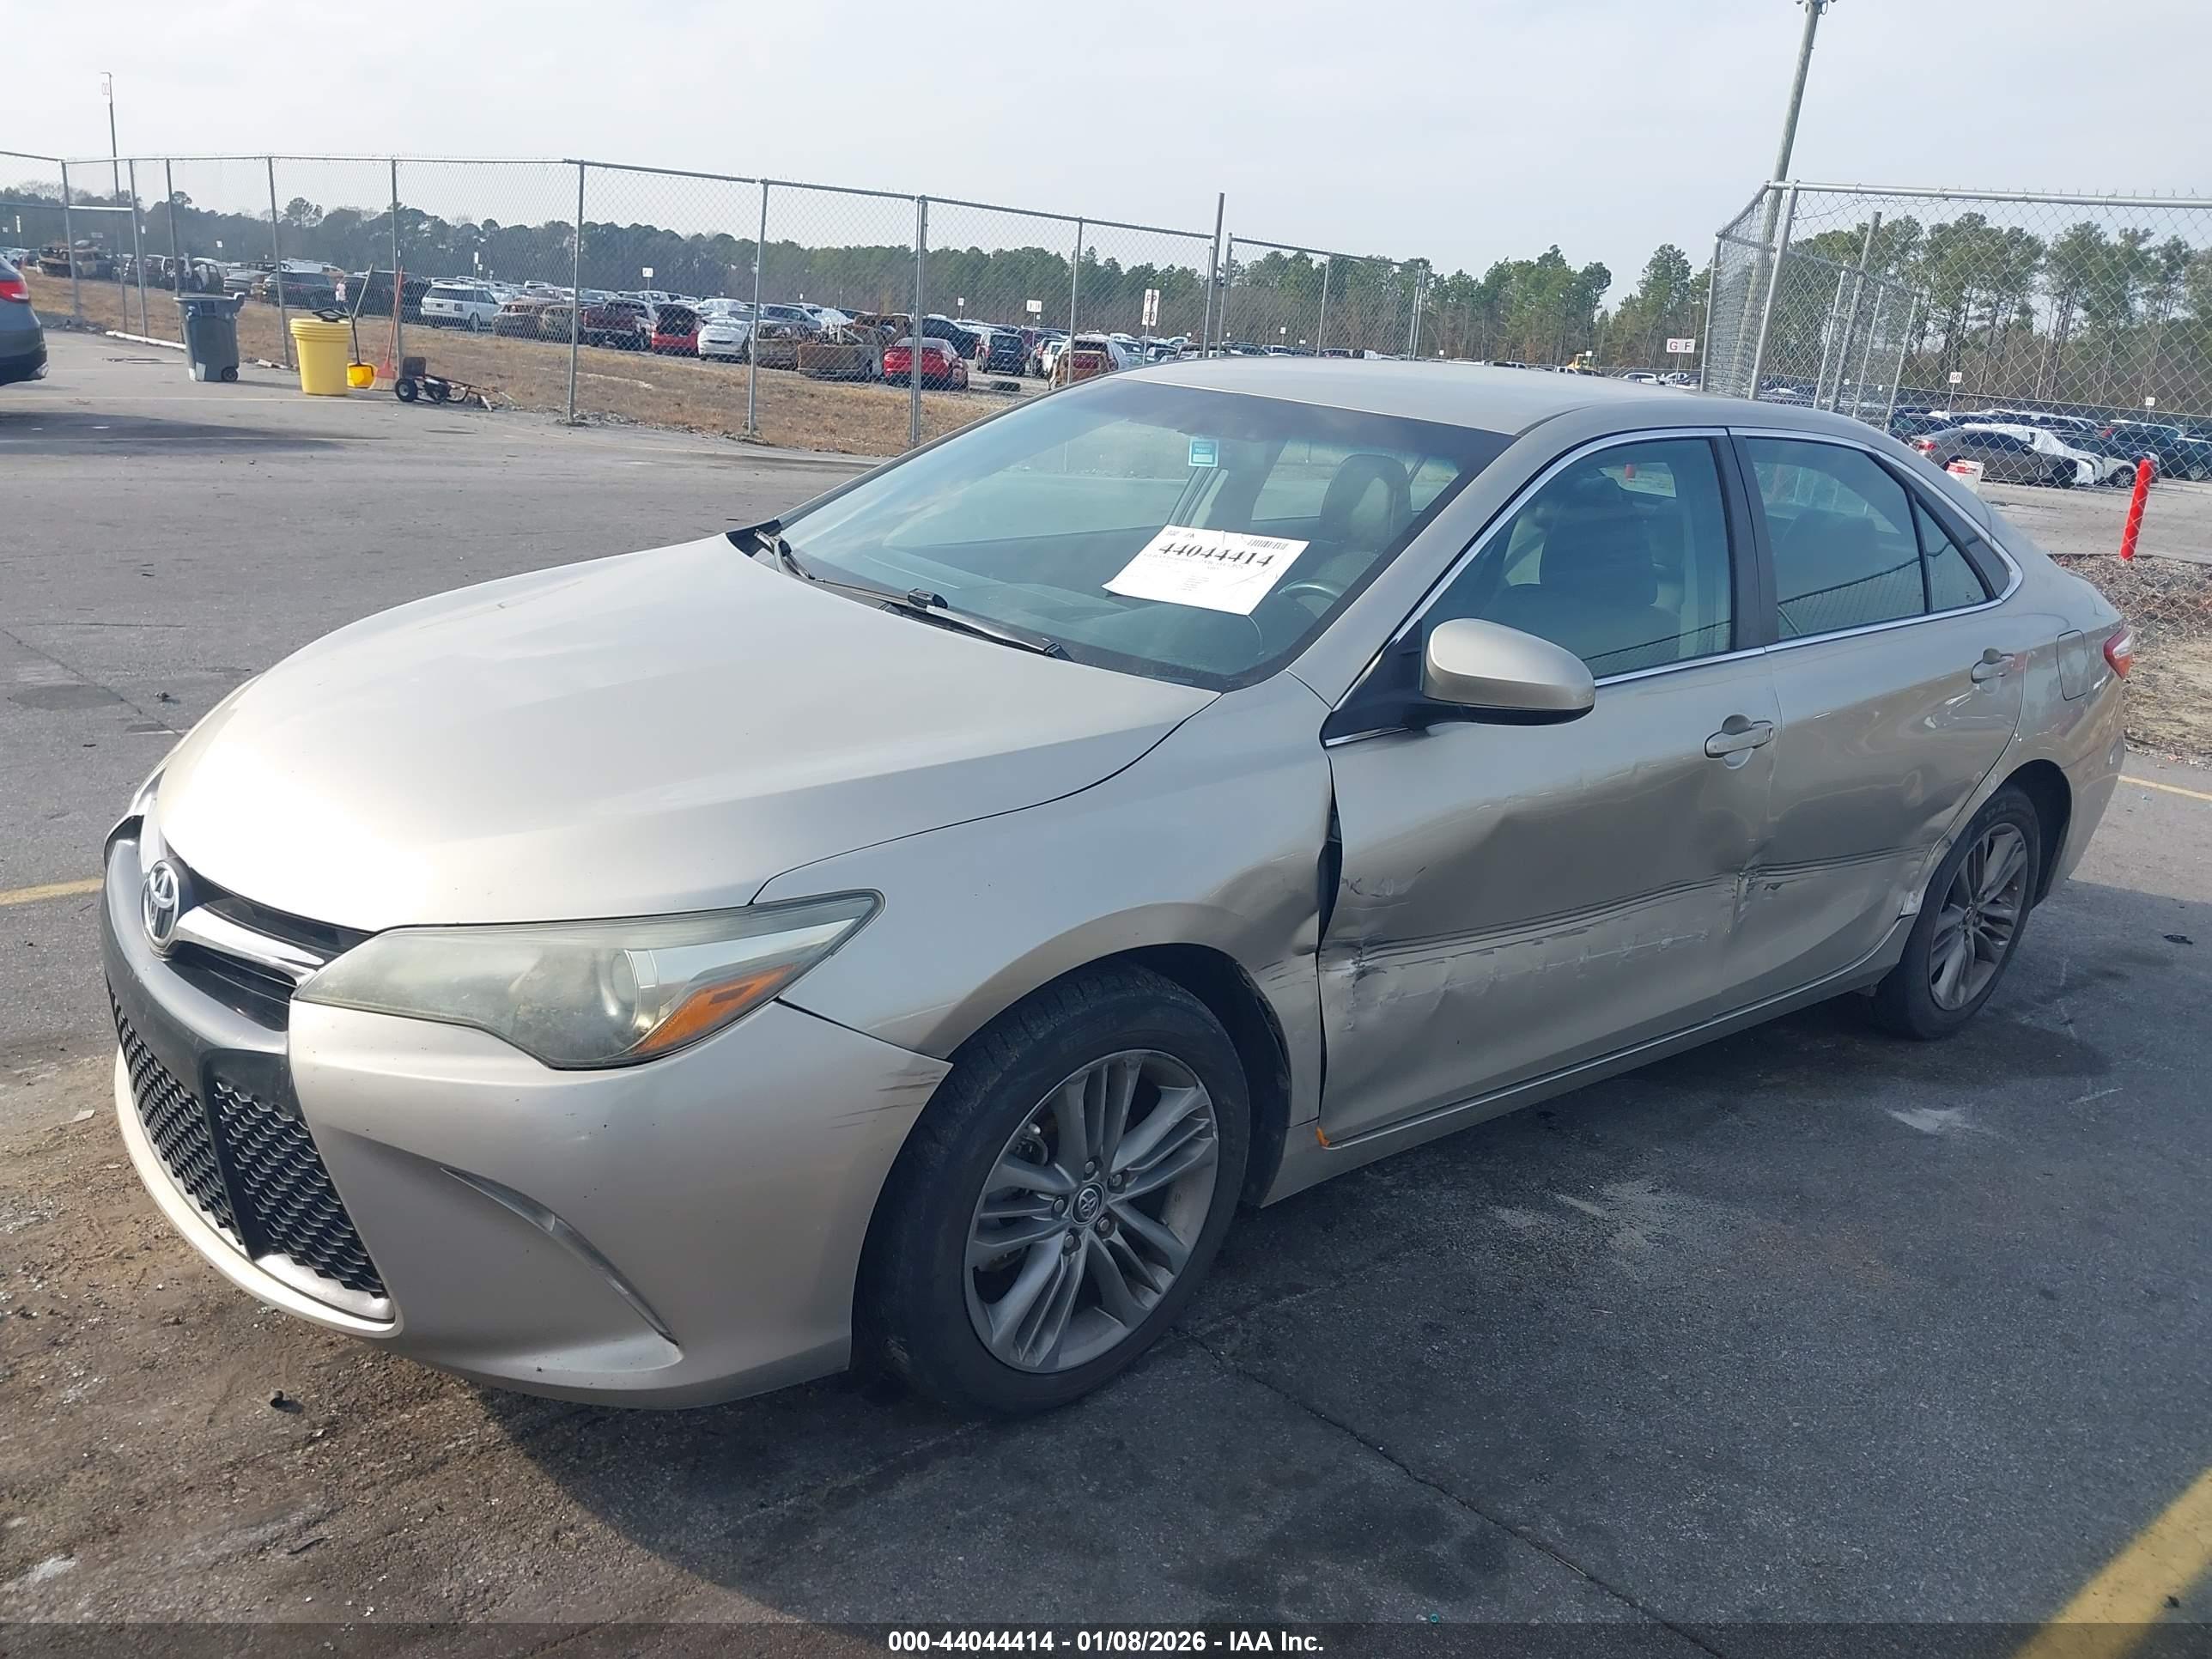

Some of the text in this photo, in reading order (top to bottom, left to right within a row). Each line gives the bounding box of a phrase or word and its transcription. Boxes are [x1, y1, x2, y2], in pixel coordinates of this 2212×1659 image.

[1669, 342, 1692, 350] G F
[1158, 542, 1275, 568] 44044414
